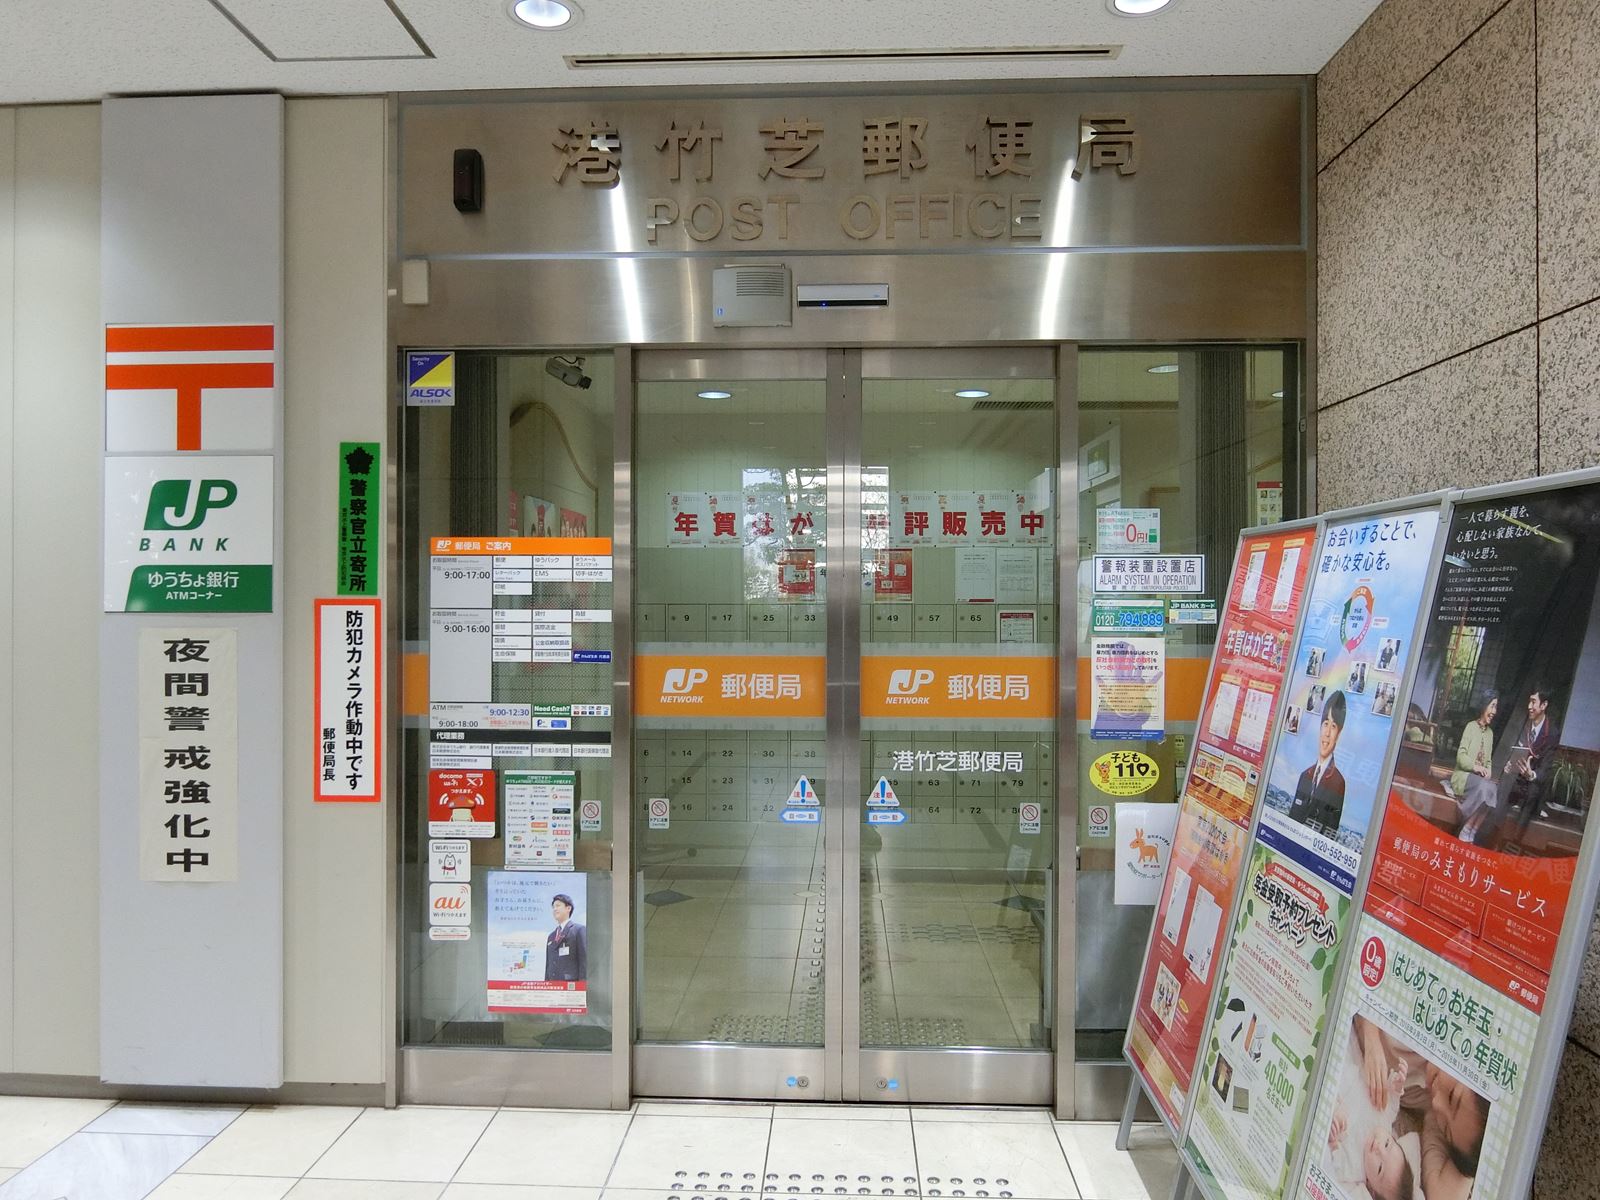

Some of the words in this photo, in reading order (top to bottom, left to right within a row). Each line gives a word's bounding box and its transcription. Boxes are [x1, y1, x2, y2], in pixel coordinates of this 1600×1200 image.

[552, 112, 1140, 187] 港竹芝郵便局
[646, 194, 798, 243] POST
[840, 192, 1041, 241] OFFICE
[410, 389, 452, 397] ALSOK
[1460, 505, 1529, 524] 一人で暮らす親を、
[349, 479, 368, 592] 警察官立寄所
[1328, 519, 1416, 548] お会いすることで、
[1456, 523, 1543, 543] 心配しない家族なんて、
[139, 538, 230, 552] BANK
[486, 542, 512, 551] ご案内
[1452, 547, 1498, 560] いないと思う。
[1101, 560, 1195, 573] 警報装置設置店
[1321, 550, 1390, 573] 確かな安心を。
[148, 571, 240, 588] ゆうちょ銀行
[444, 571, 490, 579] 9:00-17:00
[1100, 575, 1121, 585] ALARM
[1125, 575, 1150, 585] SYSTEM
[1153, 575, 1159, 585] IN
[1163, 575, 1197, 585] OPERATION
[166, 591, 223, 600] ATMコーナー
[444, 625, 490, 633] 9:00-16:00
[1225, 628, 1275, 660] 年賀はがき
[721, 673, 801, 699] 郵便局
[948, 675, 1030, 700] 郵便局
[345, 610, 363, 790] 防犯カメラ作動中です
[660, 695, 704, 703] NETWORK
[163, 638, 211, 873] 夜間警戒強化中
[323, 728, 335, 782] 郵便局長
[893, 750, 1023, 772] 港竹芝郵便局
[1111, 753, 1140, 763] 子ども
[1312, 837, 1357, 870] 0120-552-950
[1393, 836, 1546, 918] 郵便局のみまもりサービス
[434, 897, 466, 910] au
[1254, 873, 1335, 946] 年金受取予約プレゼント
[1269, 908, 1305, 947] キャンペーン
[1412, 996, 1518, 1092] はじめての年賀状
[1264, 1060, 1294, 1107] 40,000
